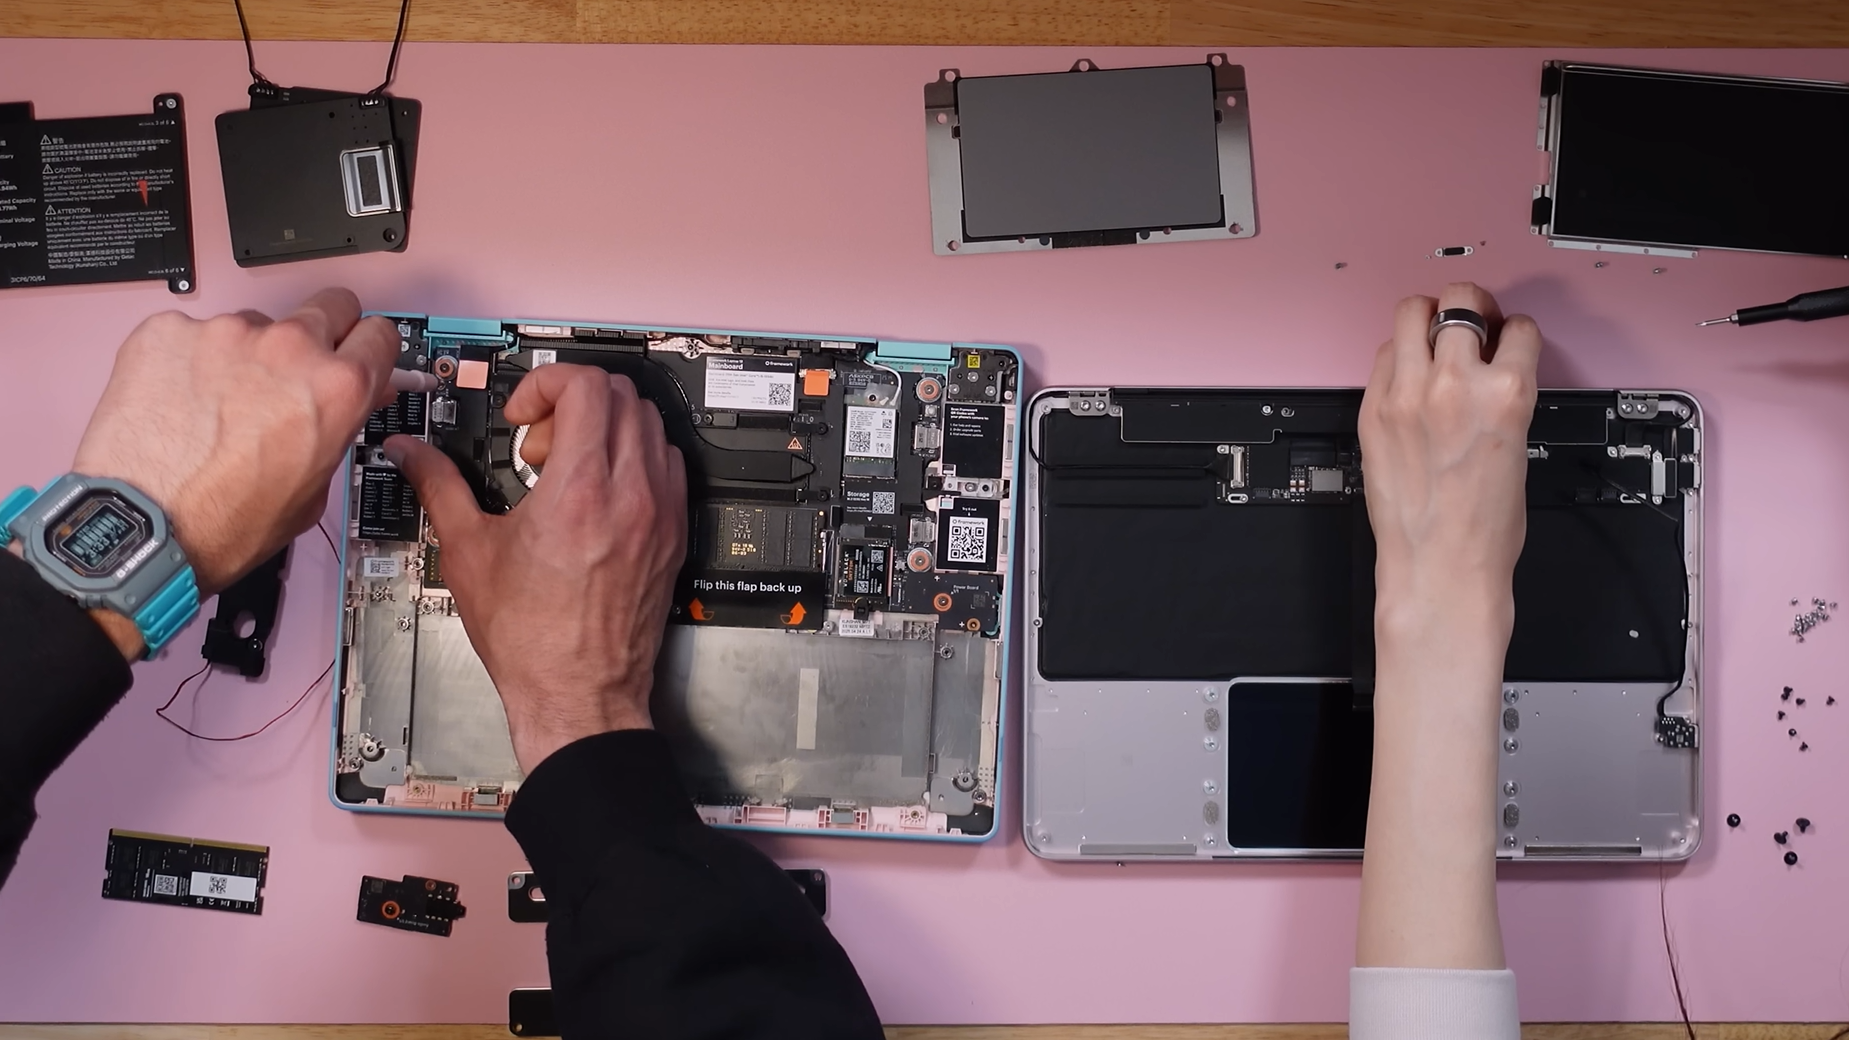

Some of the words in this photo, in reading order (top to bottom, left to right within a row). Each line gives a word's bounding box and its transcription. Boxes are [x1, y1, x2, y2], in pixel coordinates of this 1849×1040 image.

[42, 485, 84, 522] PROTECTION
[115, 539, 159, 579] G-SHOCK
[694, 580, 713, 590] Flip
[716, 581, 734, 590] this
[737, 581, 757, 592] flap
[760, 582, 785, 592] back
[788, 585, 802, 594] up
